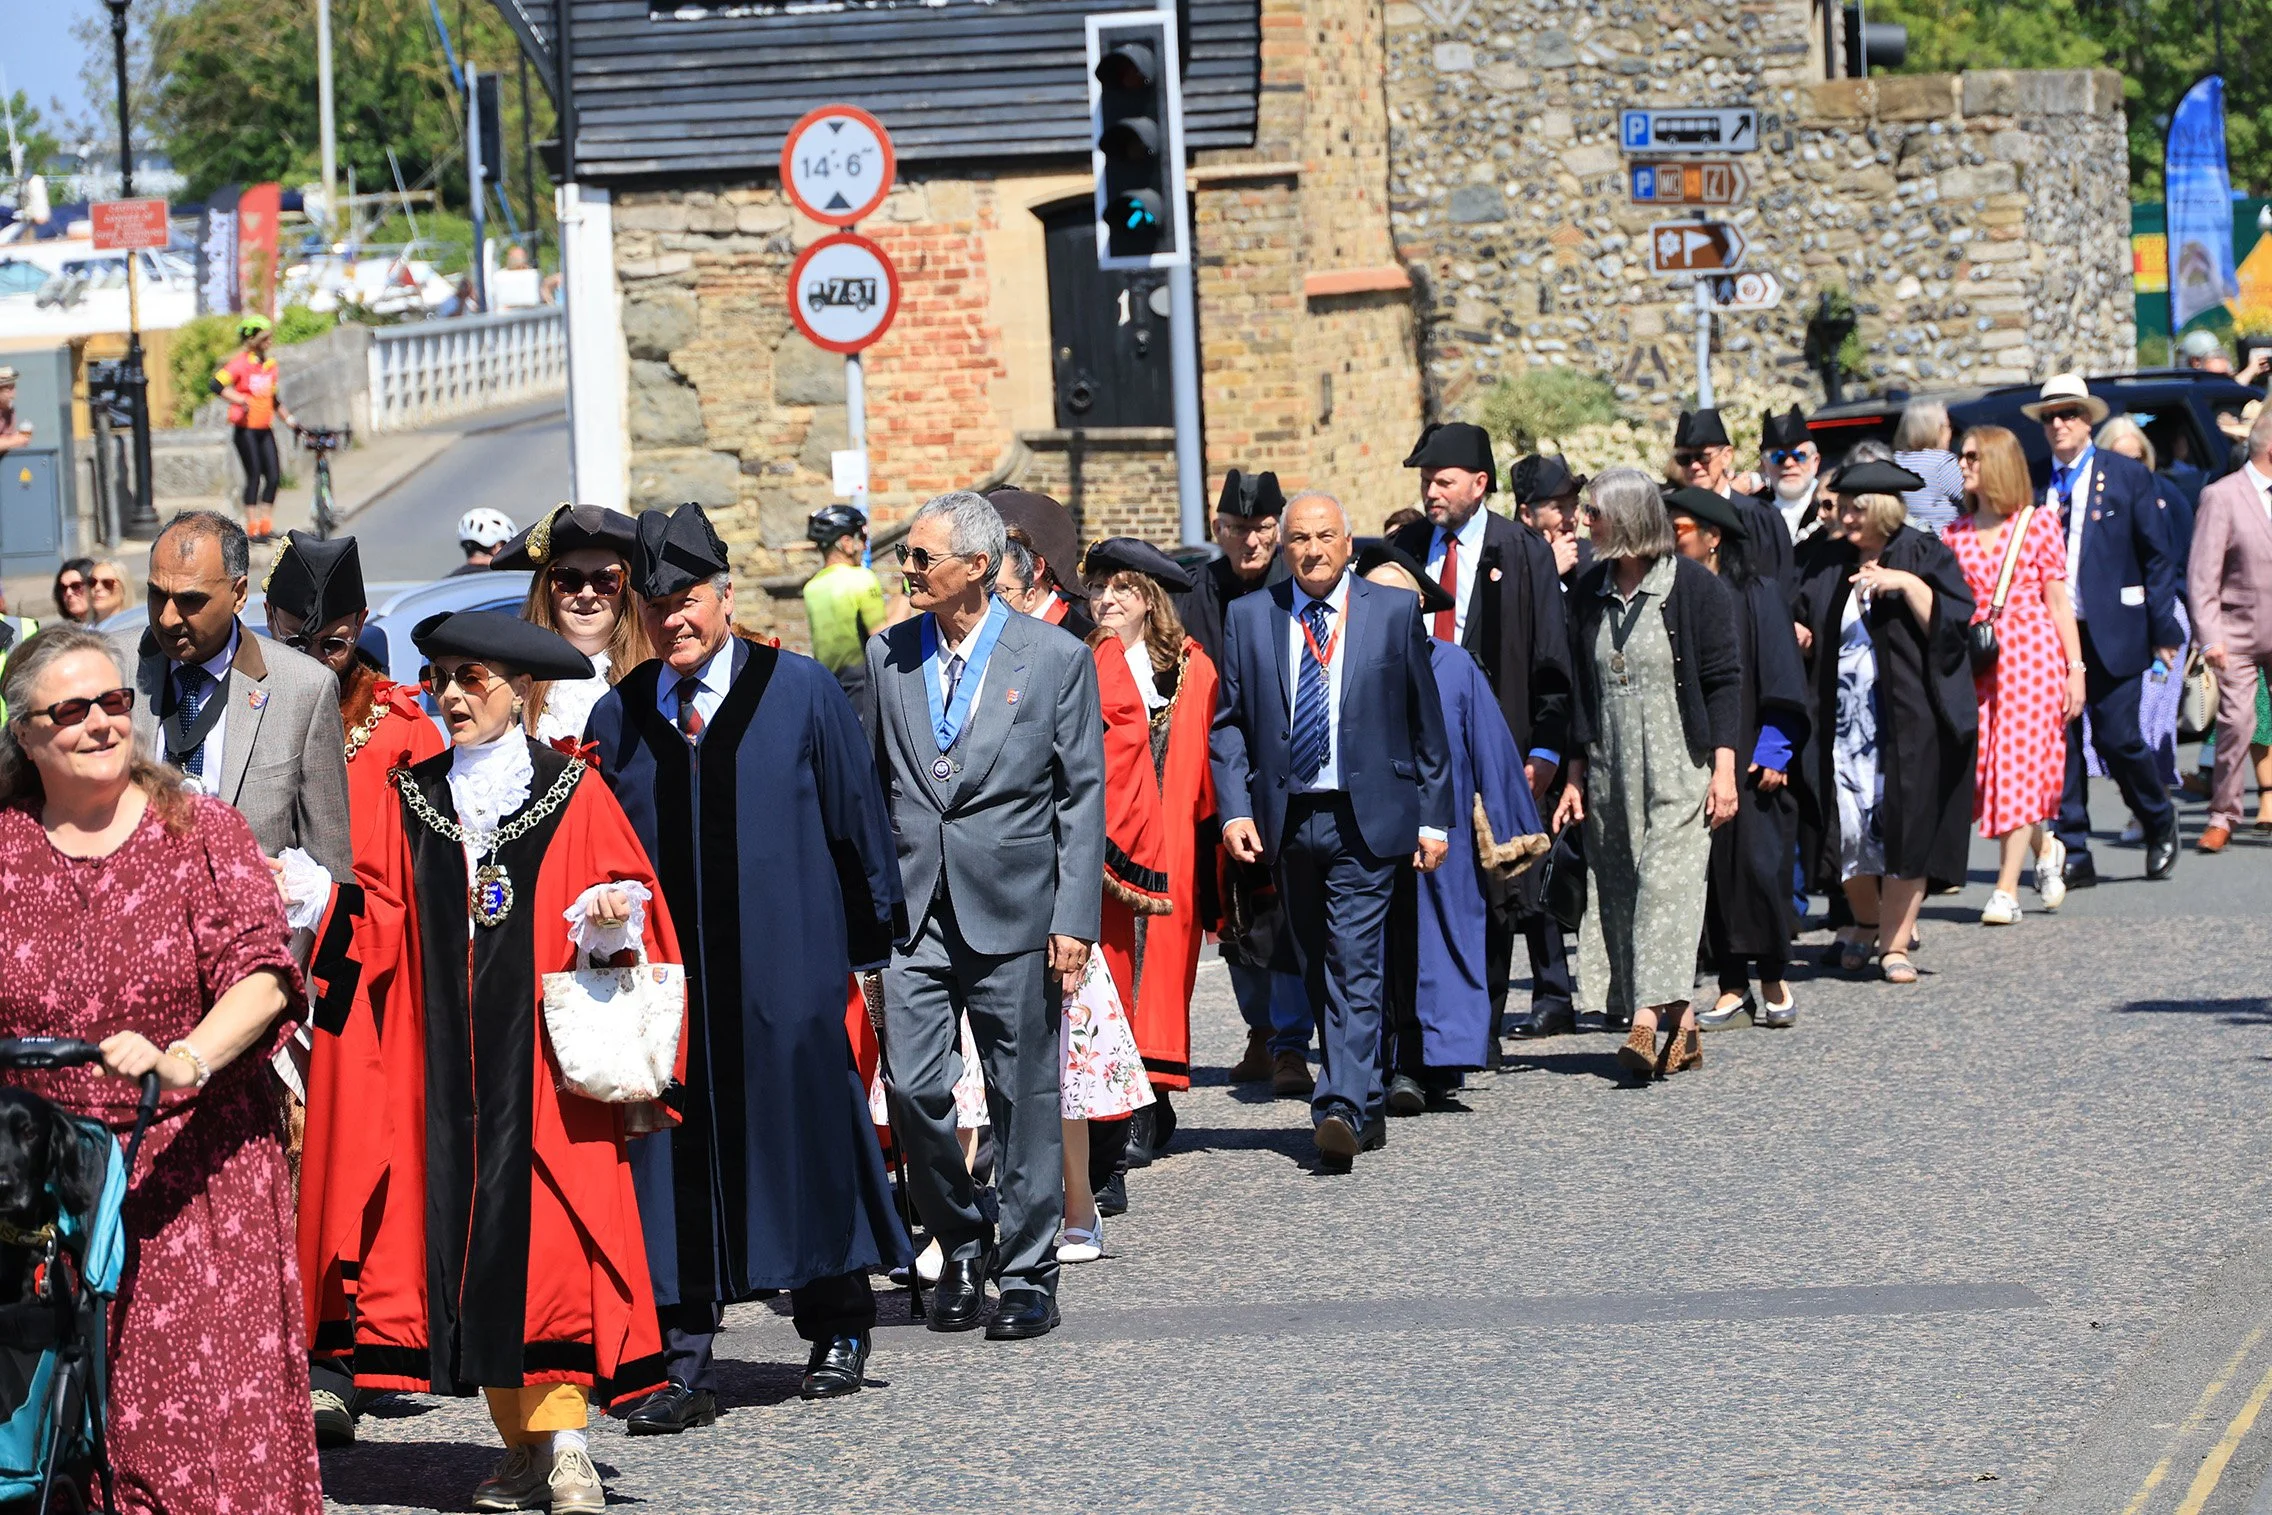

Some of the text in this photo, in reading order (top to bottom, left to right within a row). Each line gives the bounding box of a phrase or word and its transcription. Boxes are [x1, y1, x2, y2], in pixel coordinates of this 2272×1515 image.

[1628, 115, 1646, 144] P
[1636, 170, 1651, 197] P
[830, 279, 875, 304] 7.5T
[1117, 289, 1131, 326] 1
